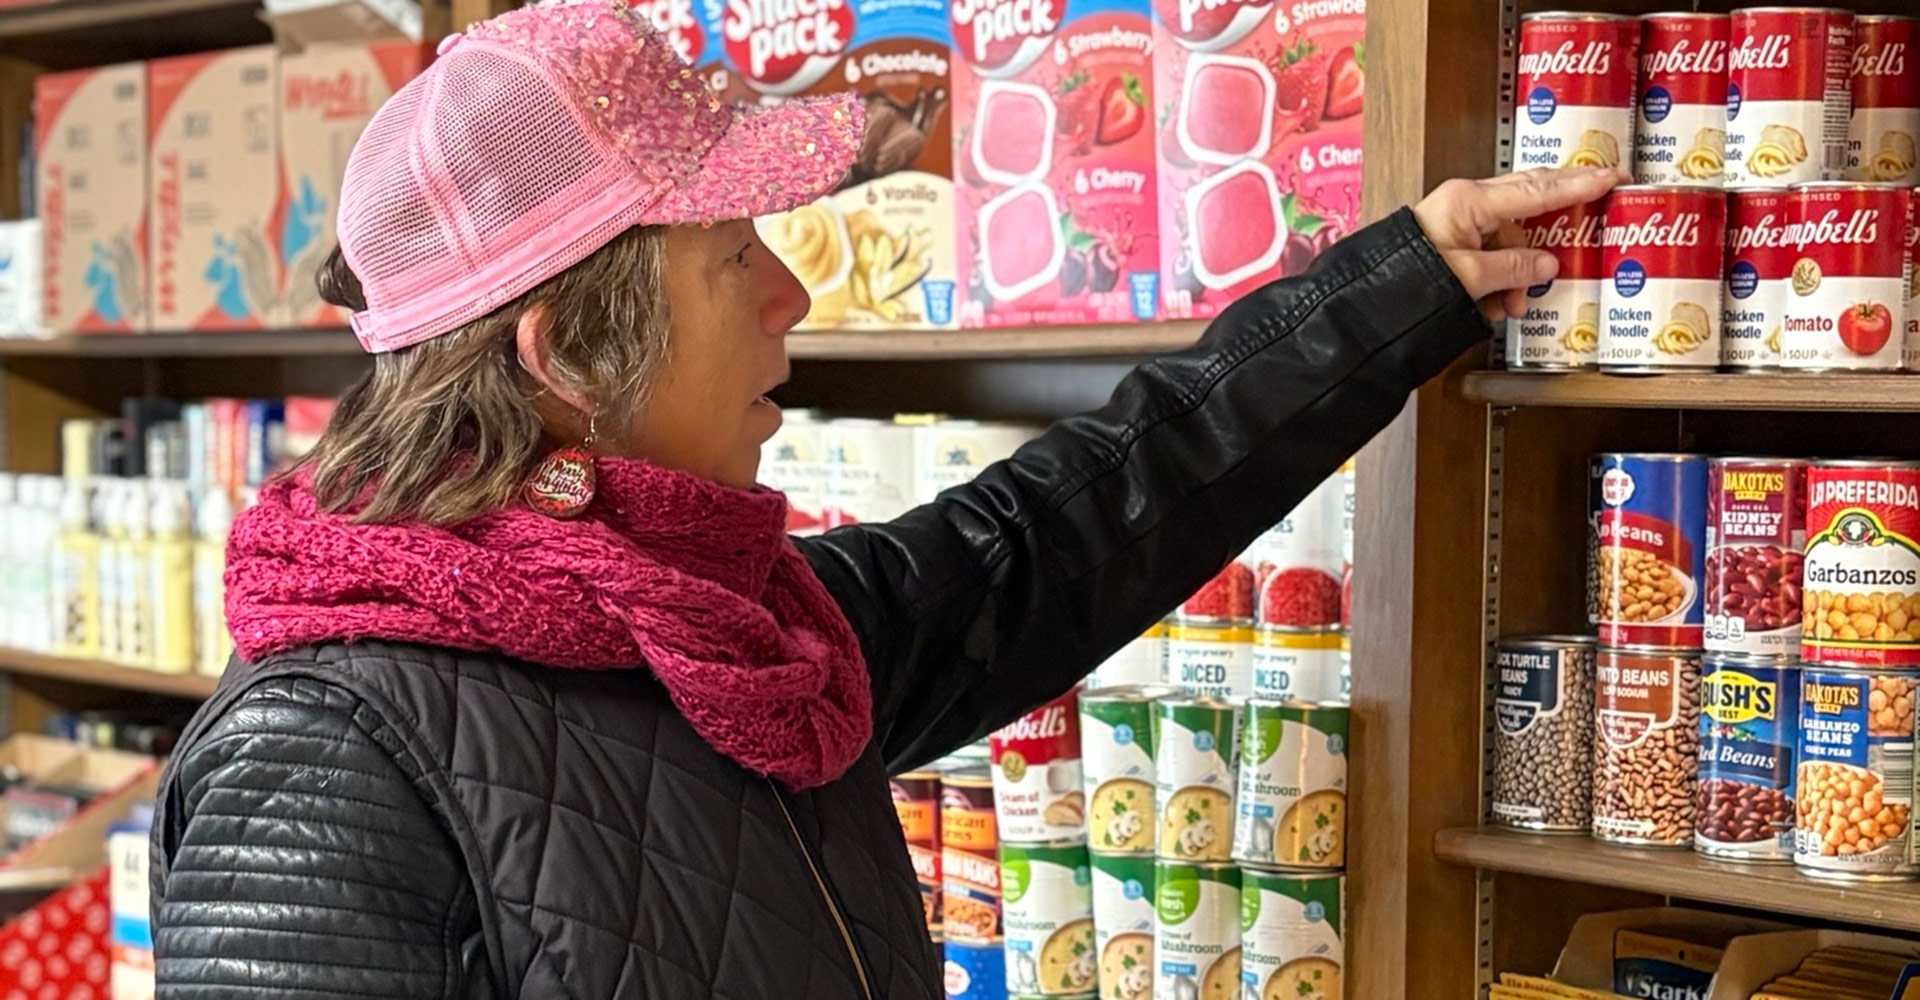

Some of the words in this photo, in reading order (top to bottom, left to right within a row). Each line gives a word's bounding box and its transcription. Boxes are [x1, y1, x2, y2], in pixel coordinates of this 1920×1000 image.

[726, 0, 843, 41] Snac
[1275, 8, 1290, 35] 6
[973, 0, 1056, 62] pack
[750, 12, 840, 77] pack
[1055, 38, 1068, 66] 6
[1069, 26, 1154, 57] Strawberry
[846, 57, 861, 84] 6
[862, 49, 947, 77] Chocolate
[1521, 134, 1562, 149] Chicken
[1637, 133, 1677, 148] Chicken
[1300, 146, 1314, 173] 6
[1521, 150, 1559, 164] Noodle
[1638, 149, 1674, 163] Noodle
[1075, 168, 1089, 195] 6
[1090, 167, 1146, 194] Cherry
[866, 185, 878, 205] 6
[882, 184, 938, 203] Vanilla
[1609, 307, 1652, 321] Chicken
[1723, 310, 1764, 323] Chicken
[1609, 323, 1649, 338] Noodle
[1784, 315, 1834, 332] Tomato
[1723, 325, 1762, 339] Noodle
[1611, 348, 1642, 359] SOUP
[1725, 349, 1755, 360] SOUP
[1789, 349, 1818, 359] SOUP
[1723, 471, 1784, 492] DAKOTA'S
[1810, 481, 1823, 509] LA
[1826, 479, 1919, 511] PREFERIDA
[1722, 511, 1783, 525] KIDNEY
[1724, 523, 1778, 537] BEANS
[1808, 559, 1917, 586] Garbanzos
[1511, 654, 1551, 670] TURTLE
[1181, 663, 1226, 684] DICED
[1501, 669, 1529, 685] BEANS
[1623, 667, 1670, 687] BEANS
[1617, 688, 1649, 699] SODIUM
[1703, 681, 1772, 714] BUSH'S
[1805, 683, 1859, 706] DAKOTA'S
[1718, 708, 1740, 720] BEST
[1803, 718, 1860, 734] GARBANZO
[1806, 729, 1854, 745] BEANS
[1720, 746, 1777, 770] Beans
[1161, 940, 1223, 955] Mushroom
